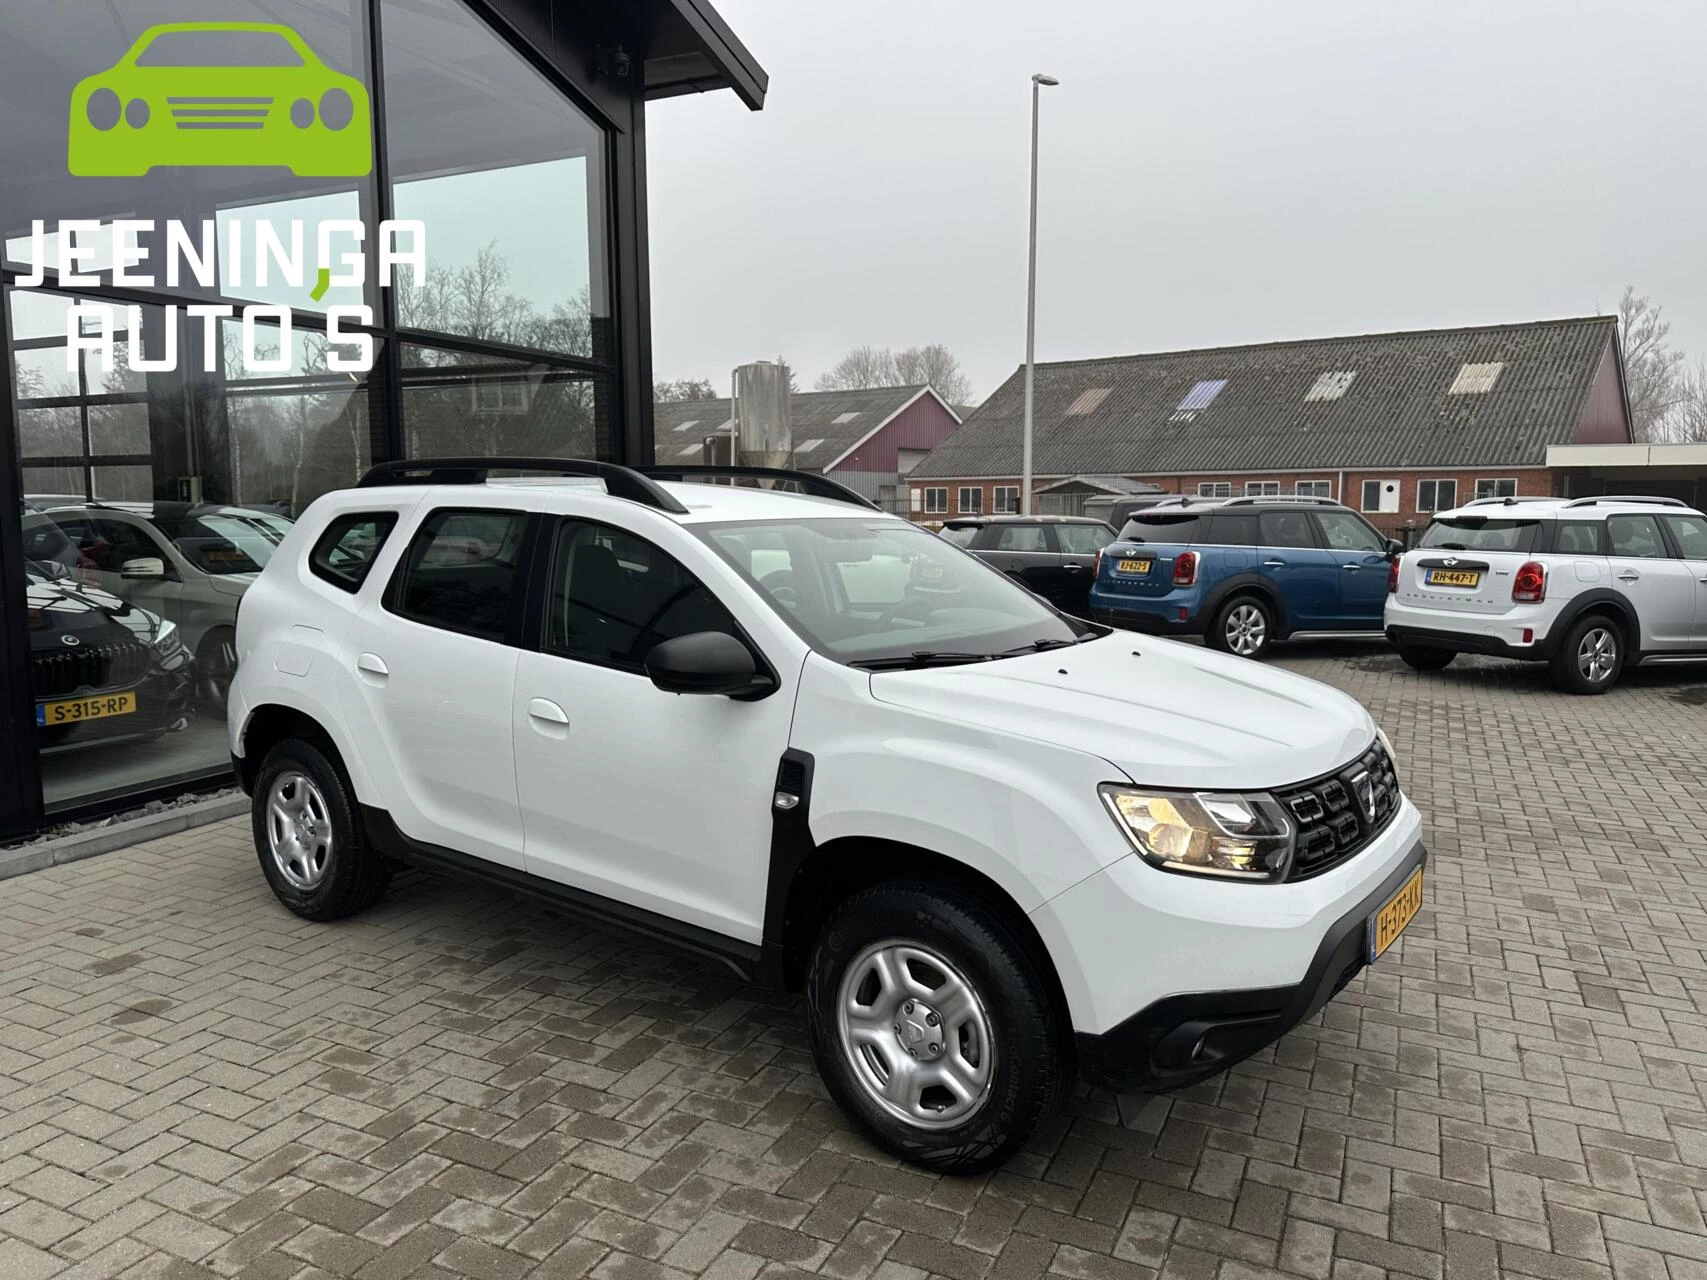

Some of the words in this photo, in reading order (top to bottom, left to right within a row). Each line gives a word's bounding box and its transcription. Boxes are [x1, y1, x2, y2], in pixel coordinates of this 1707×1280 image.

[1433, 572, 1475, 584] RH-447-T
[54, 696, 128, 721] S-315-RP
[1380, 877, 1420, 947] H-373-KK
